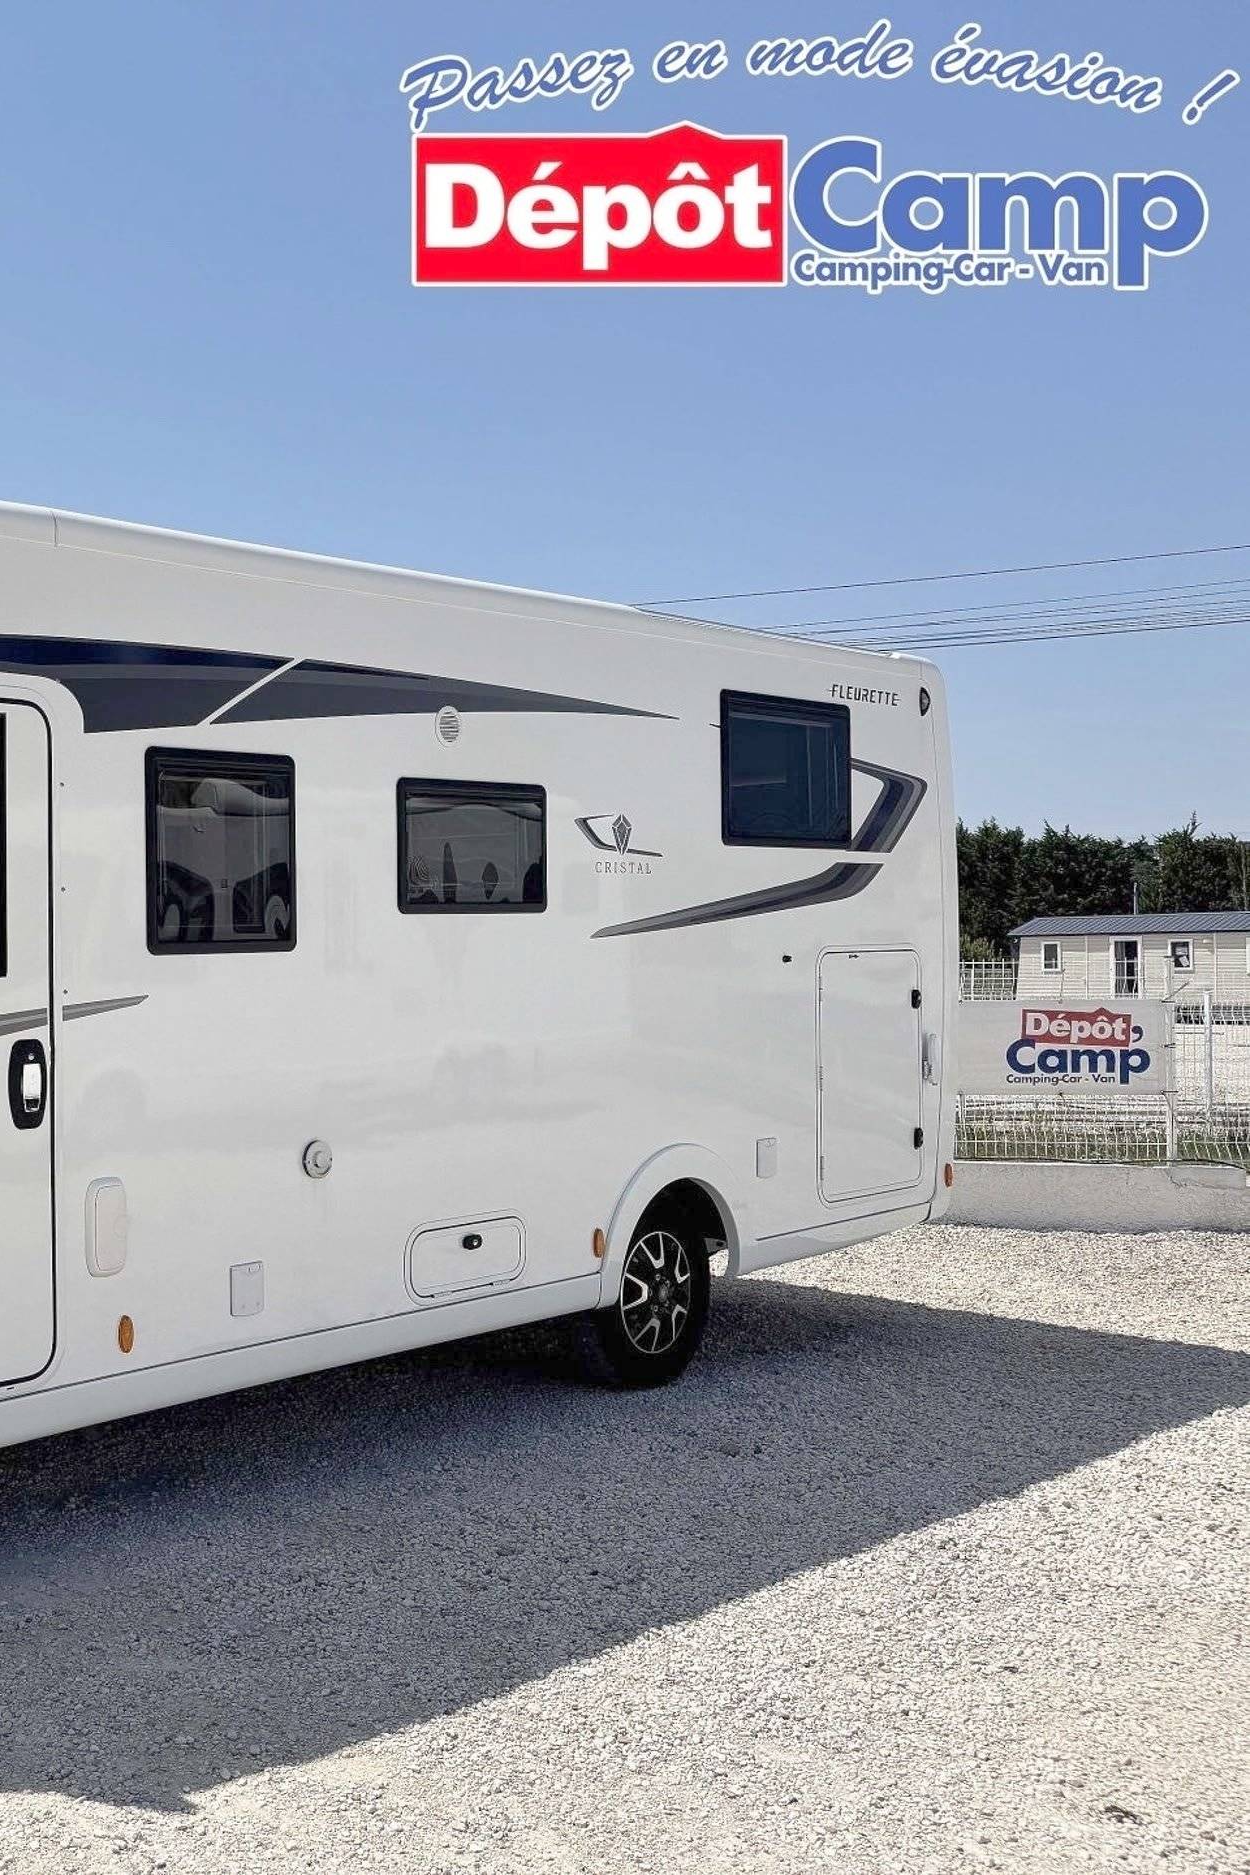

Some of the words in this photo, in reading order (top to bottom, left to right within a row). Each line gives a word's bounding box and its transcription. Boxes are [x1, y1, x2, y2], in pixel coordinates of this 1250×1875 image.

[828, 684, 901, 706] FLEURETTE
[594, 861, 652, 875] CRISTAL
[1006, 1038, 1151, 1085] Camp
[1092, 1073, 1116, 1084] Van
